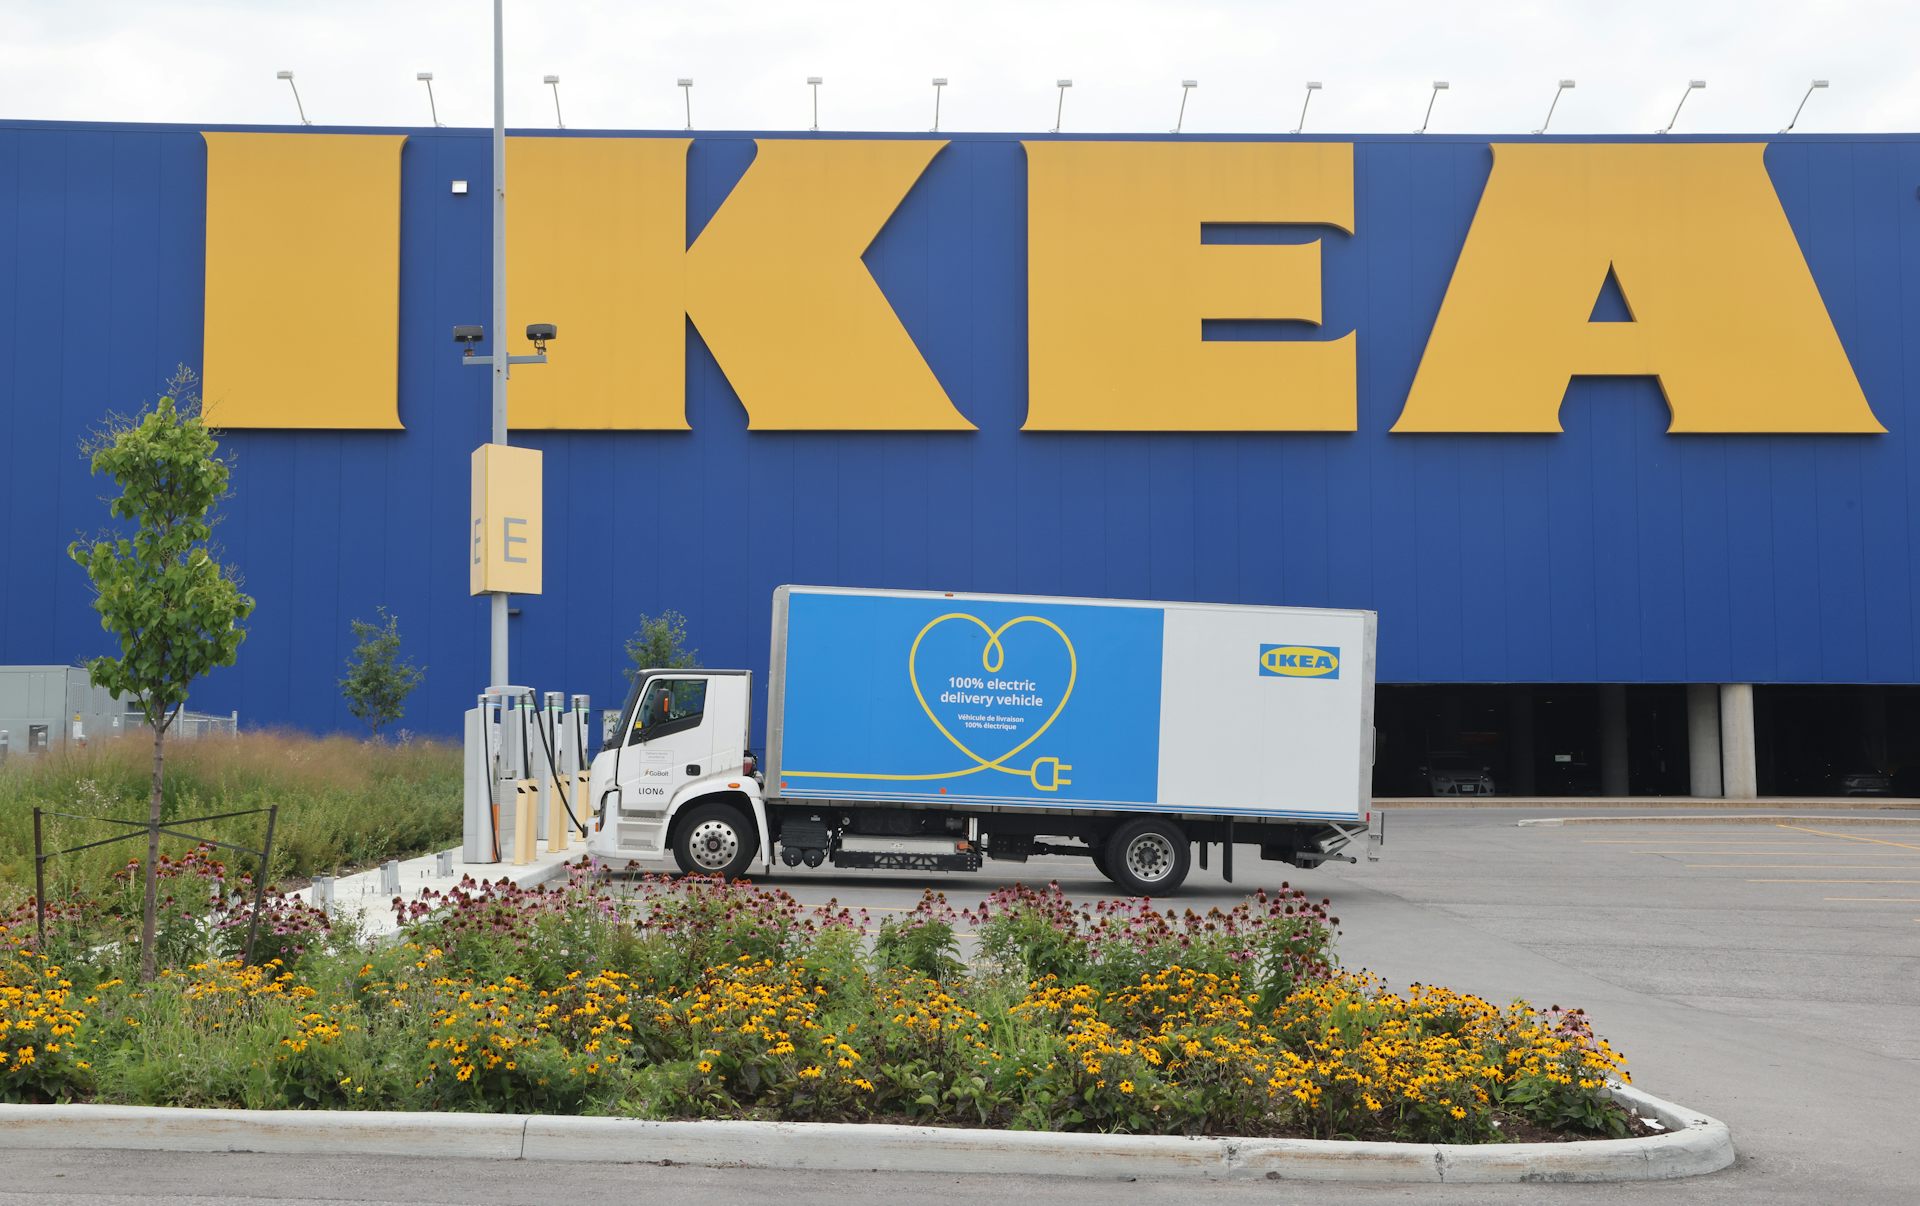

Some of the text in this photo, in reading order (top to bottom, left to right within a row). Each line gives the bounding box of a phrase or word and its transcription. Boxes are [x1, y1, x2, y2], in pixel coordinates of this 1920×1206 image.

[200, 131, 1889, 434] IKEA
[504, 517, 528, 563] E
[1267, 653, 1333, 669] IKEA
[948, 676, 1036, 691] 100% electric
[940, 691, 1044, 707] delivery vehicle
[957, 713, 1025, 723] Véhicule de livraison
[964, 721, 1017, 731] 100% électrique
[638, 787, 664, 795] LION6
